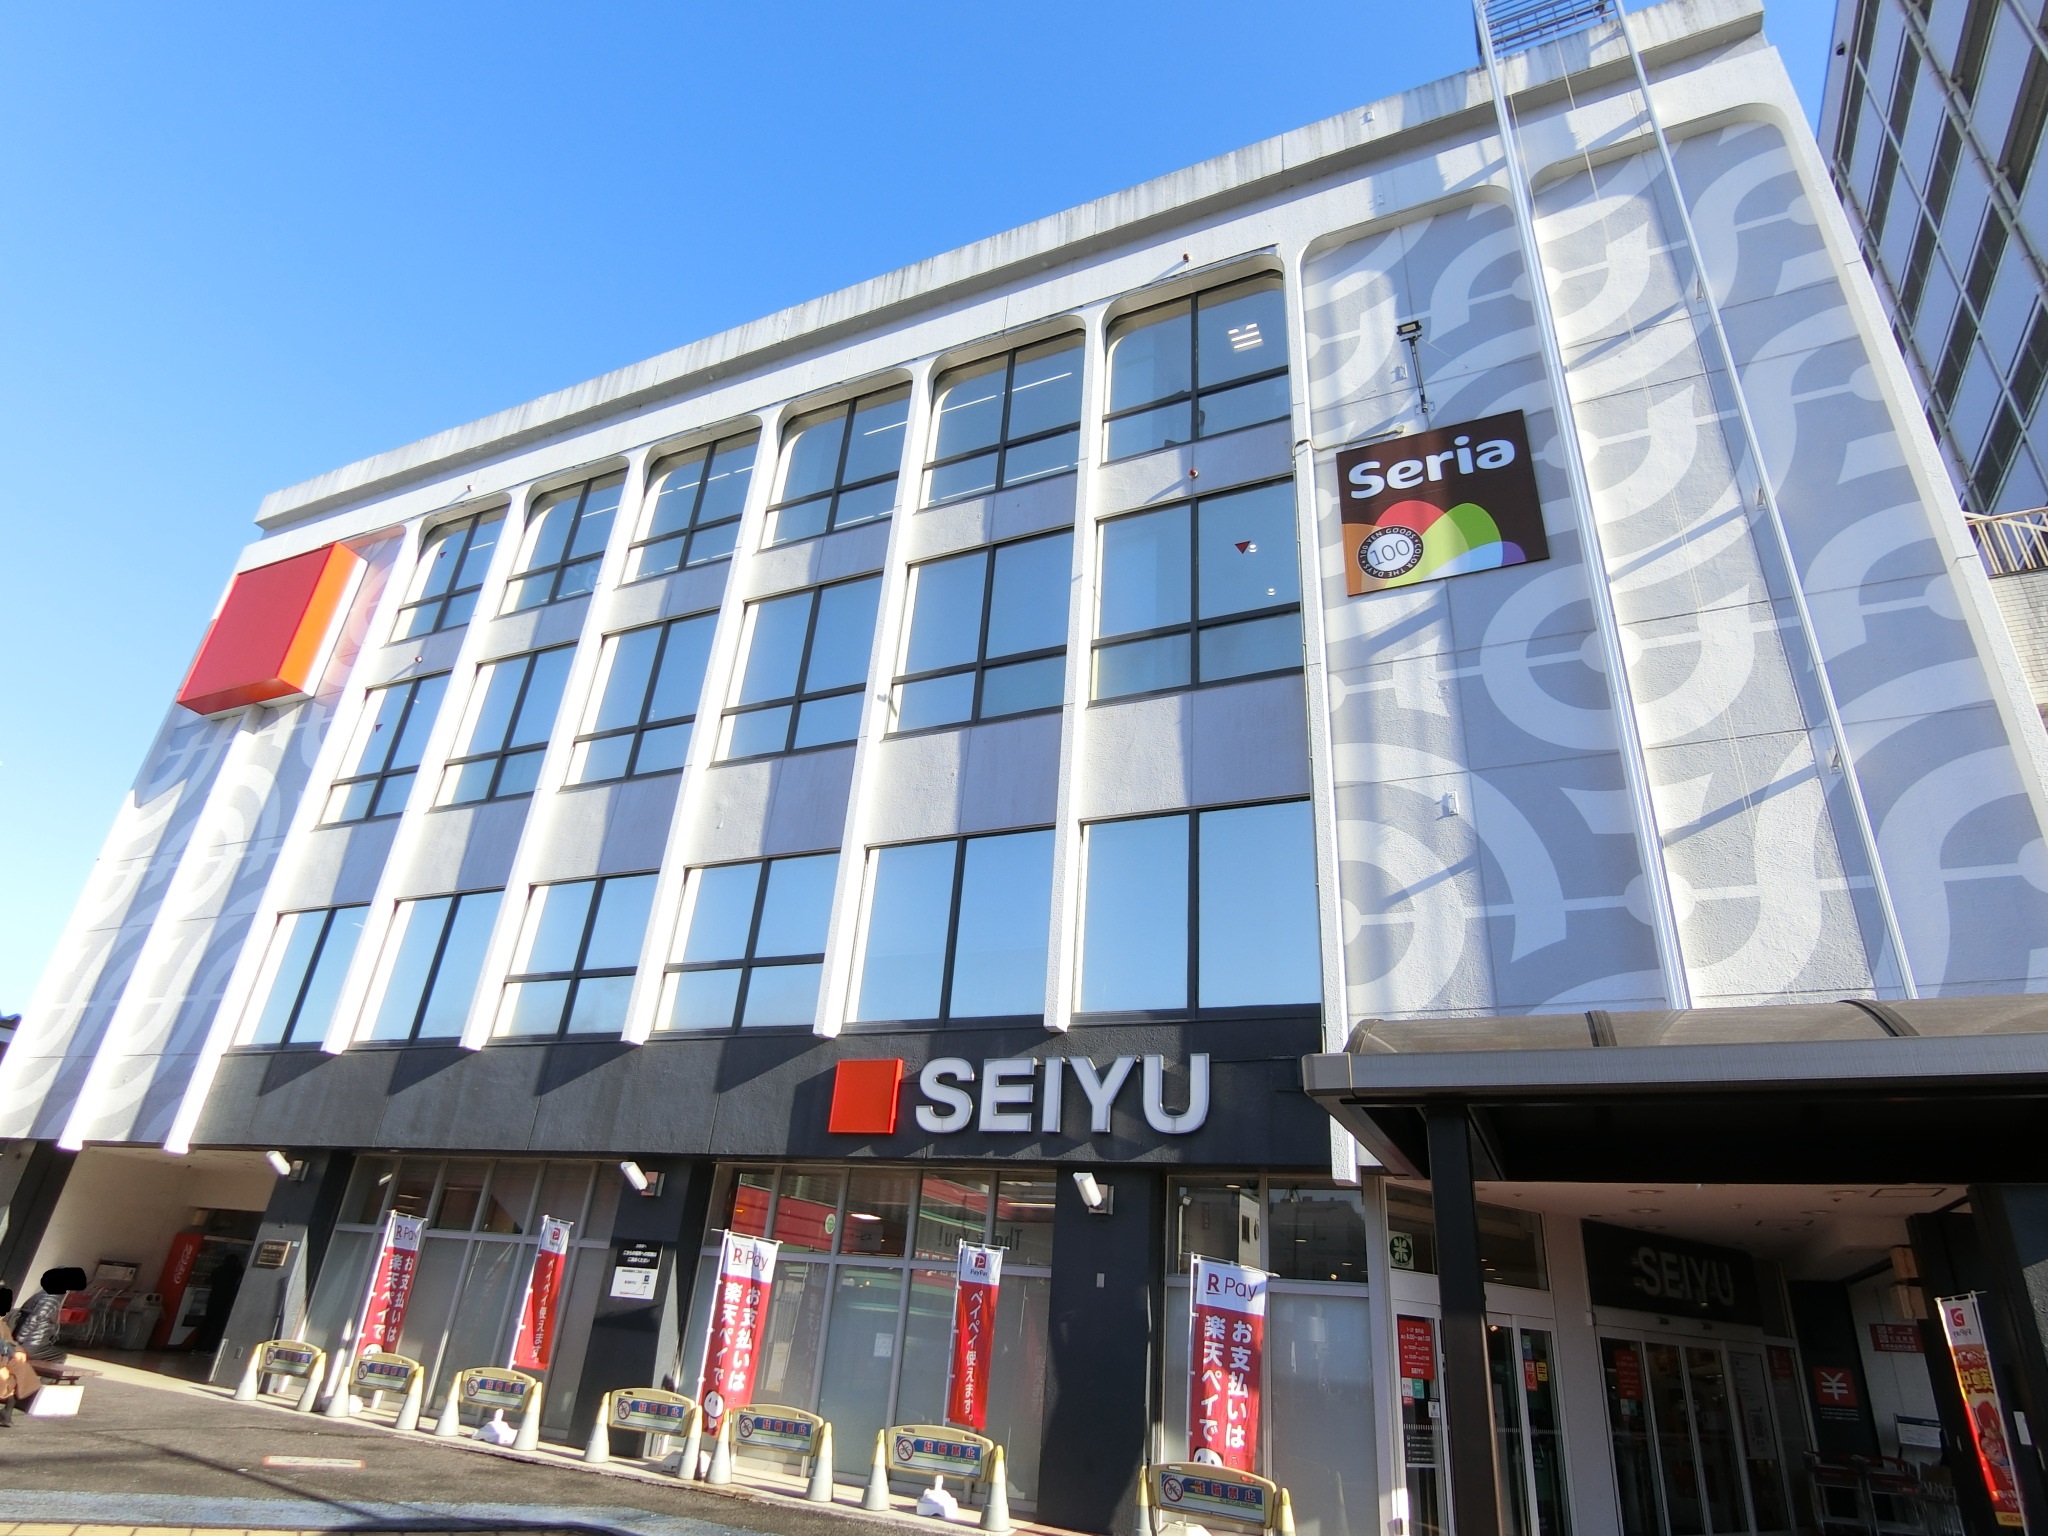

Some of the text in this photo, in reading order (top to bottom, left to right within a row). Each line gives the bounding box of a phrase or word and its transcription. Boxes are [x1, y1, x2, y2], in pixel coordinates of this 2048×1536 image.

[1348, 435, 1516, 499] Seria
[1363, 544, 1422, 577] COLOR THE DAYS
[1367, 531, 1383, 544] YEN
[1385, 527, 1417, 540] GOODS
[1370, 539, 1410, 566] 100
[915, 1052, 1210, 1135] SEIYU
[374, 1254, 403, 1339] 楽天ペイで
[745, 1250, 769, 1271] Pay
[1206, 1273, 1258, 1301] R Pay
[1637, 1246, 1735, 1306] SEIYU
[387, 1256, 413, 1342] お支払いは
[714, 1282, 744, 1386] 楽天ペイで
[728, 1288, 761, 1391] お支払いは
[964, 1290, 984, 1421] ペイペイ使えます。
[1199, 1316, 1226, 1442] 楽天ペイで
[1226, 1320, 1252, 1449] お支払いは
[923, 1440, 976, 1459] 駐輪禁止
